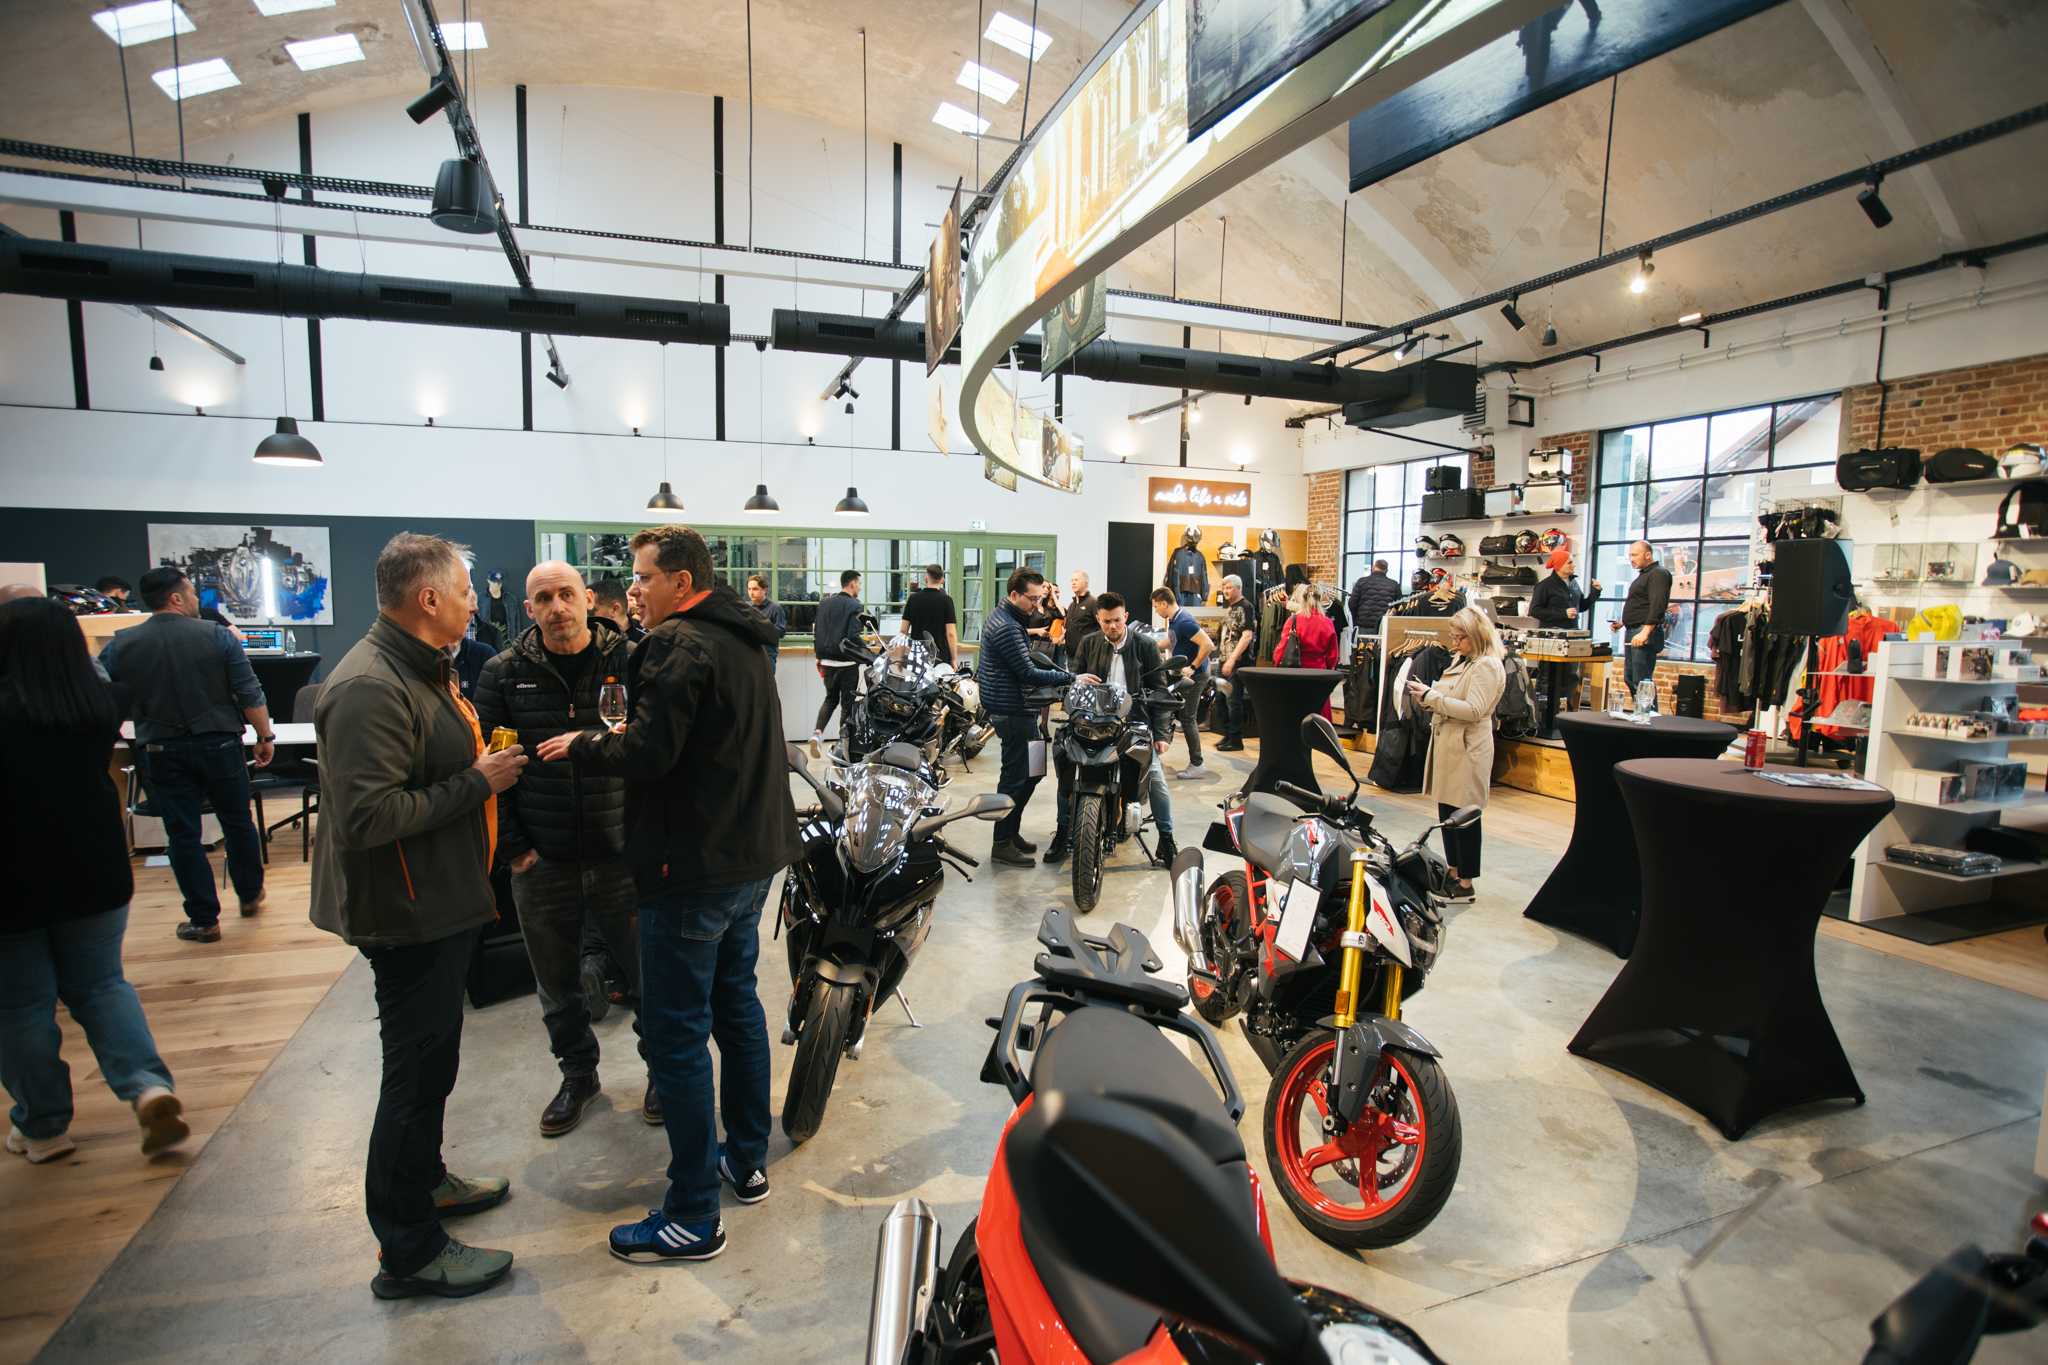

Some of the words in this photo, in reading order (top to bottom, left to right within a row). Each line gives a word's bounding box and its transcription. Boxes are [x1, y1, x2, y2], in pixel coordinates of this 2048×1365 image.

[1189, 486, 1212, 507] life
[1213, 495, 1222, 505] a
[1224, 489, 1247, 507] ride
